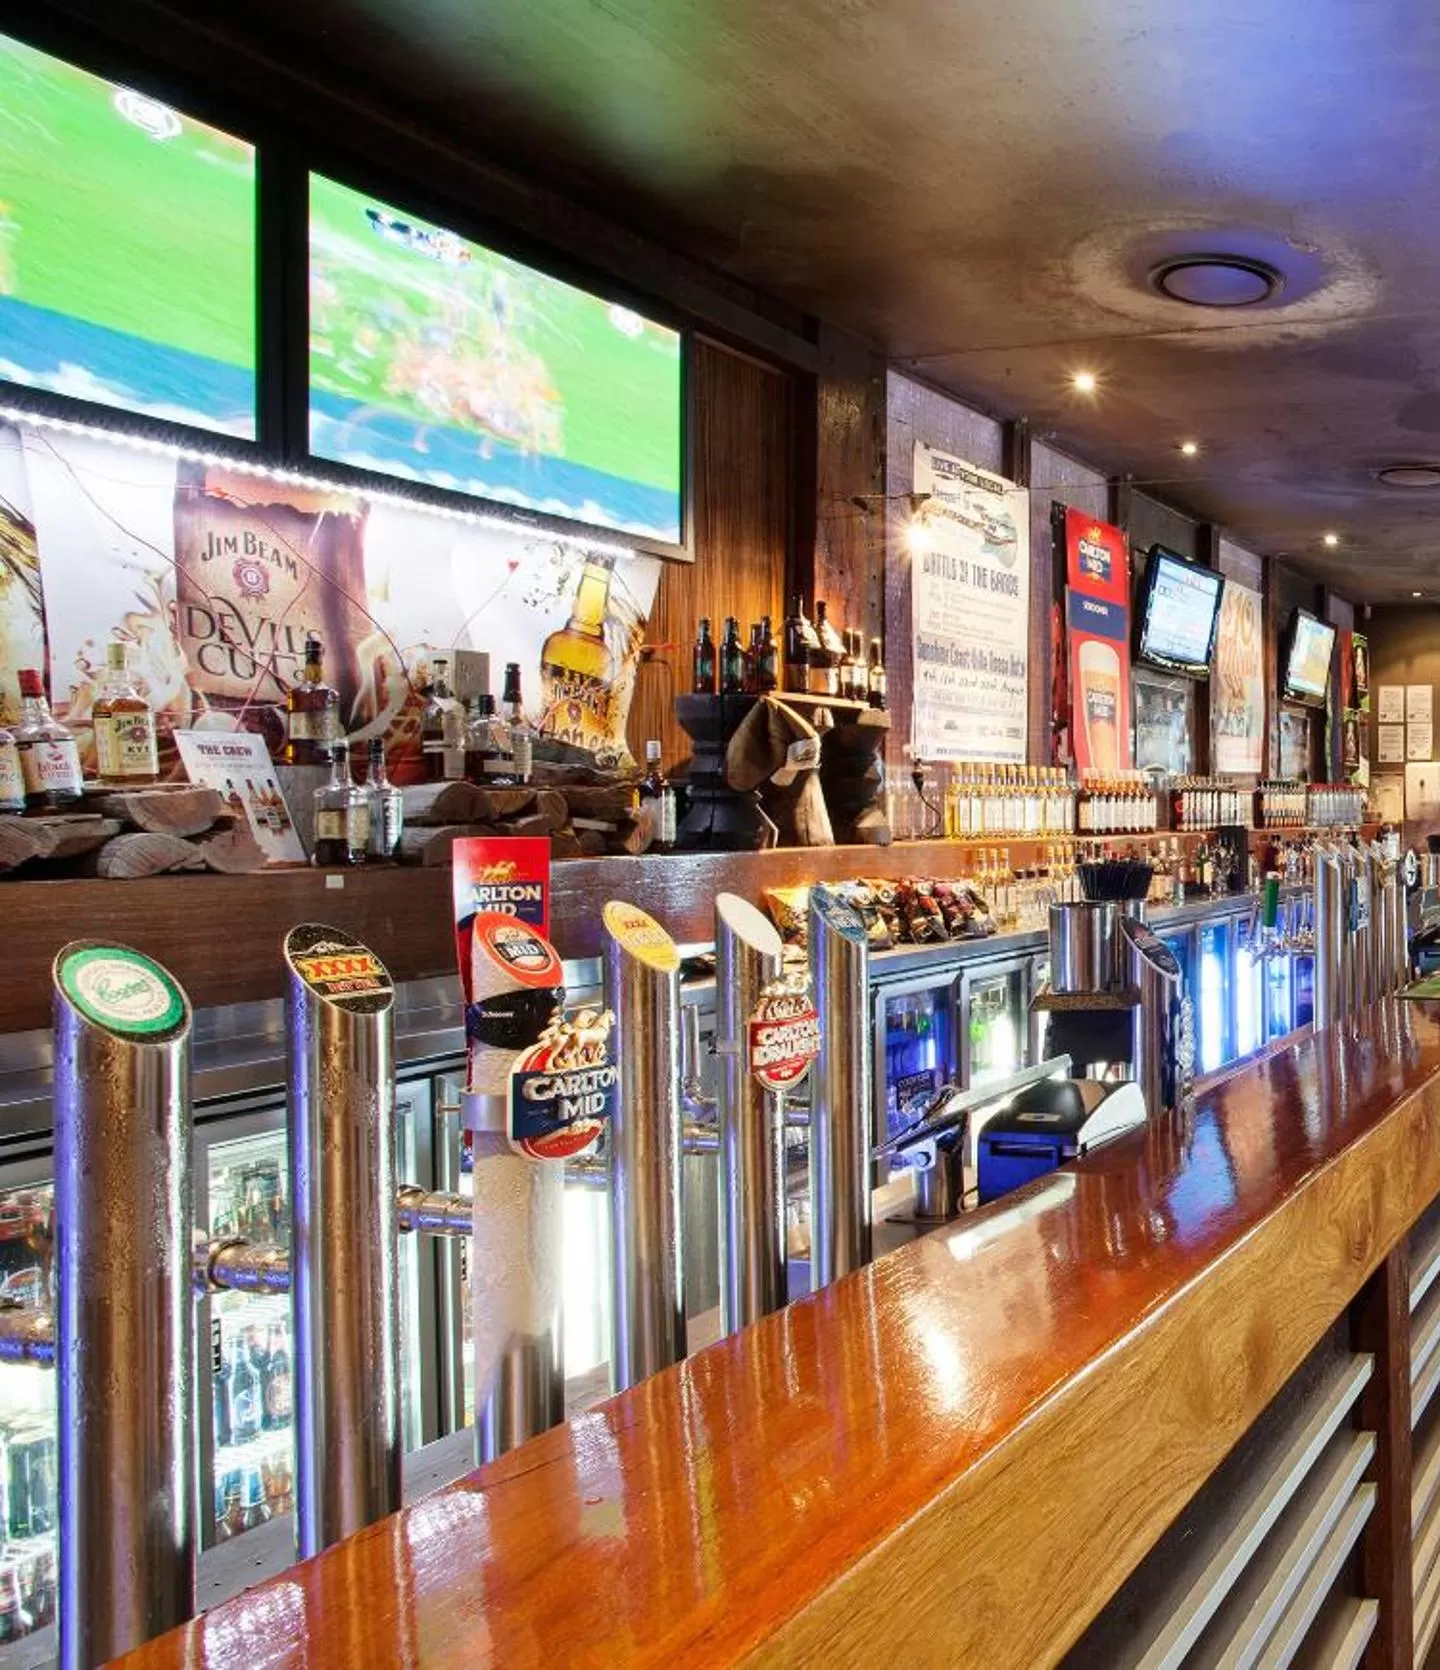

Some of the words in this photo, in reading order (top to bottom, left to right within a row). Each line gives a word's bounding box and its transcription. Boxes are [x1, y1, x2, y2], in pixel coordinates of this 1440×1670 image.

[201, 532, 237, 562] JIM
[243, 531, 298, 581] BEAM
[473, 884, 542, 902] ARLTON
[505, 941, 541, 957] MID
[311, 958, 370, 978] XXXX
[522, 1065, 619, 1101] CARLTON
[556, 1092, 606, 1121] MID
